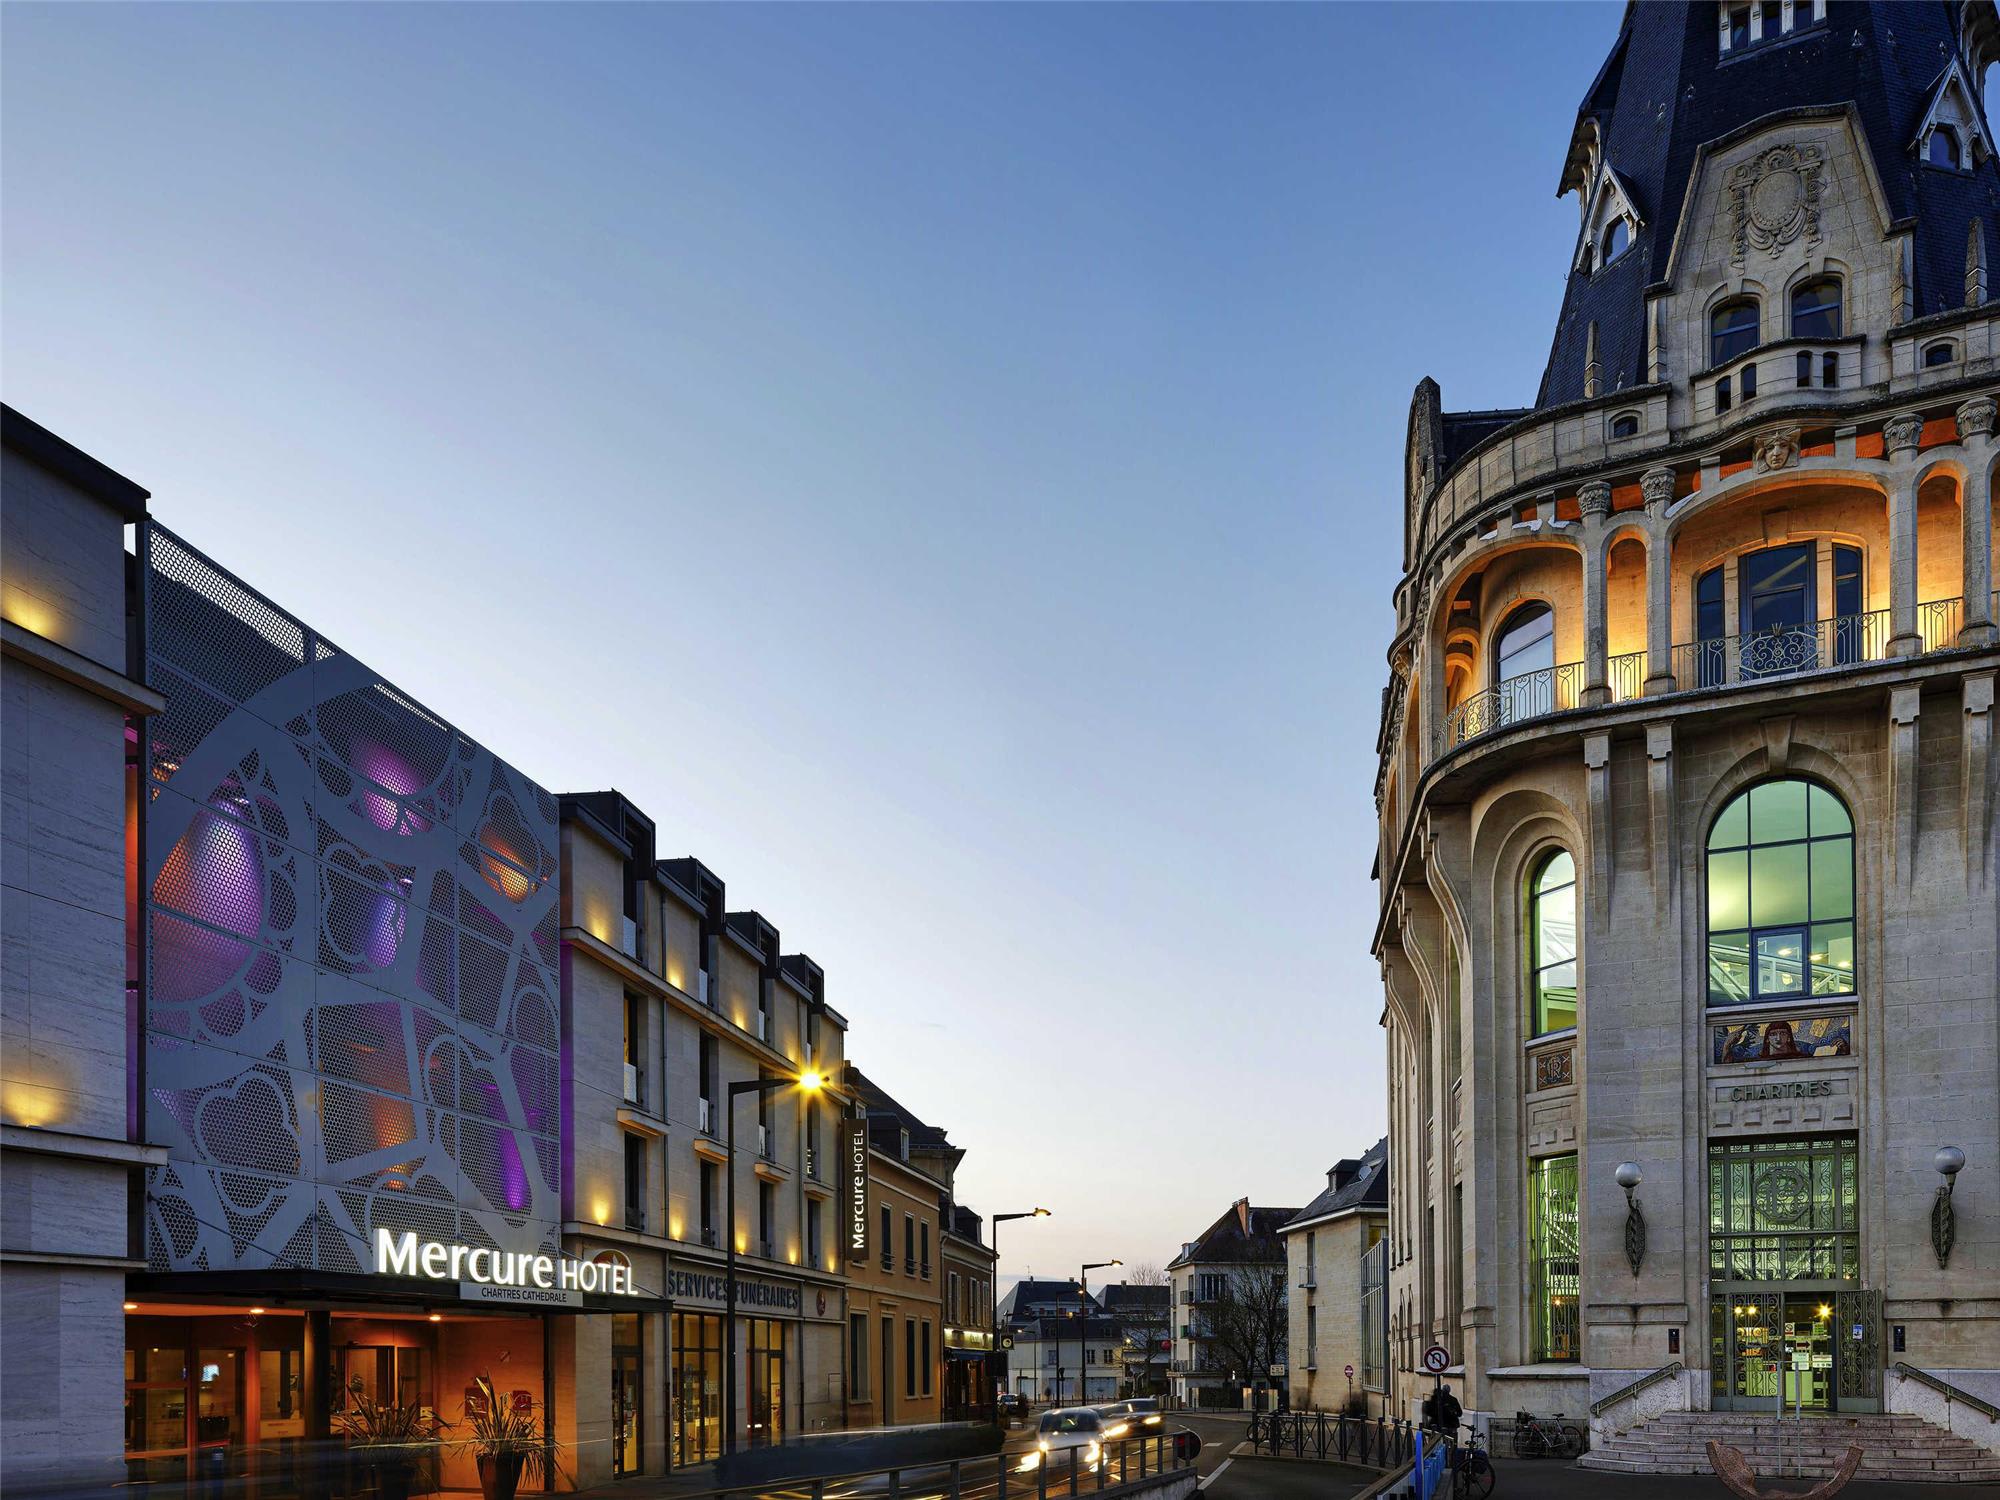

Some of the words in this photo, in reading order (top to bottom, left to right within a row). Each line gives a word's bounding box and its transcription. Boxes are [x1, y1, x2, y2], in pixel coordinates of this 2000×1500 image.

[1731, 1080, 1832, 1102] CHARTRES
[853, 1129, 864, 1173] HOTEL
[852, 1176, 865, 1249] Mercure
[373, 1228, 553, 1288] Mercure
[561, 1258, 639, 1295] HOTEL
[481, 1287, 521, 1300] CHARTRES
[522, 1290, 567, 1303] CATHEDRALE
